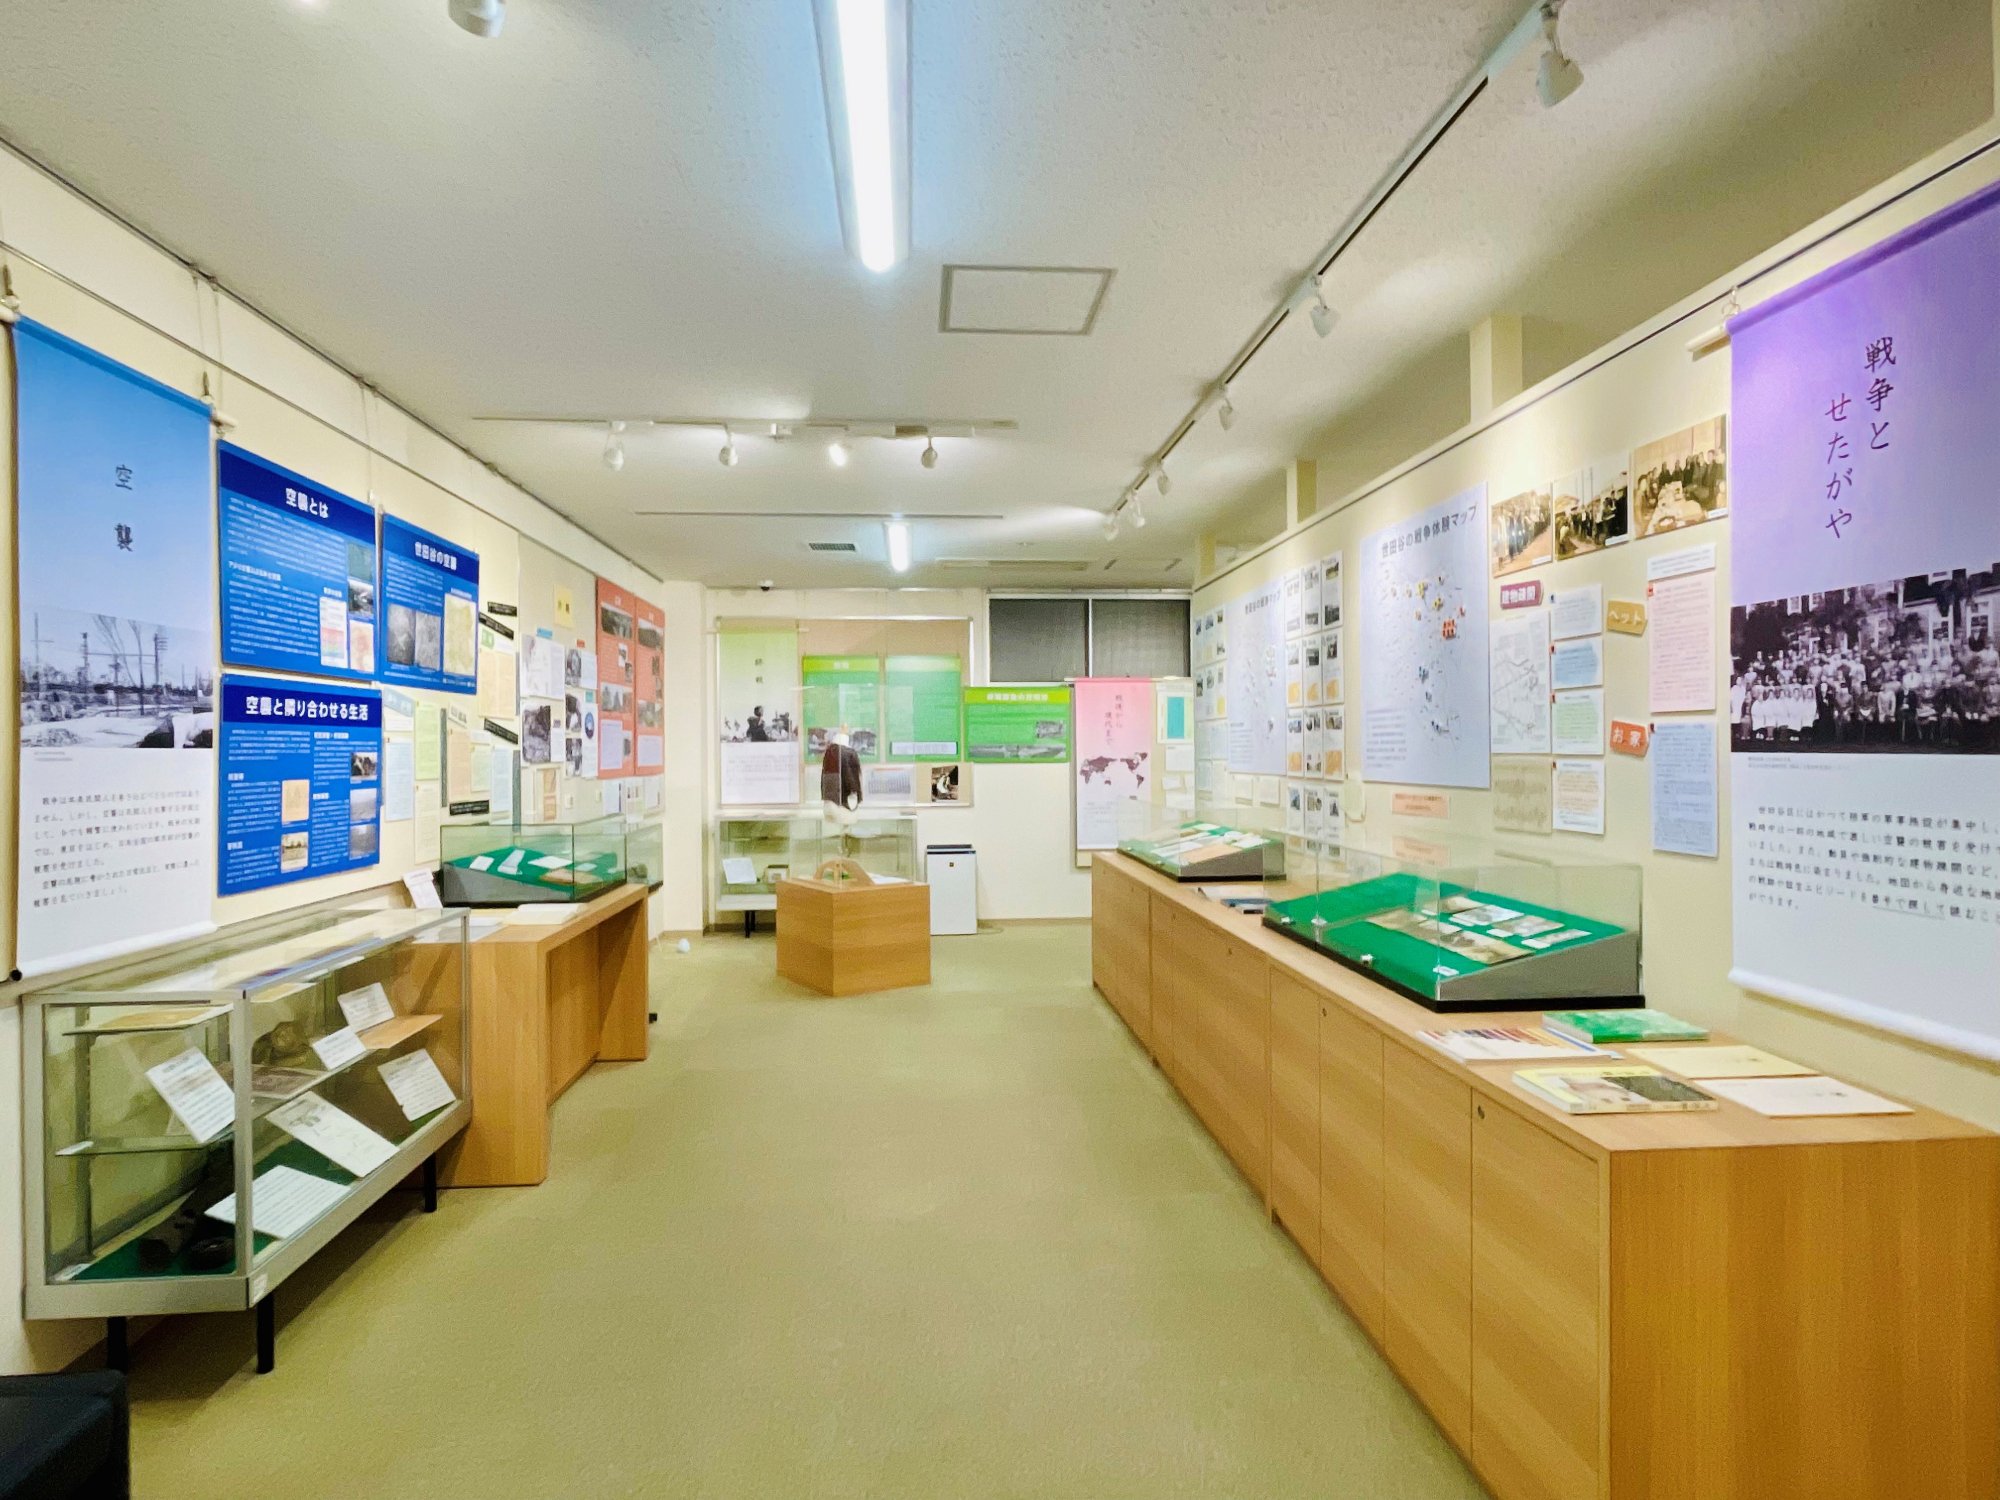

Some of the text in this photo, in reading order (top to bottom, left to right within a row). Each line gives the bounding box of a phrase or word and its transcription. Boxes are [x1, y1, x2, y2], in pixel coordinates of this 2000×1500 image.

[1864, 336, 1897, 451] 戦争と
[1825, 393, 1853, 539] せたがや
[114, 464, 134, 552] 空襲
[285, 487, 330, 519] 空襲とは
[1382, 502, 1477, 558] 世田谷の戦争体験マップ
[245, 695, 369, 721] 空襲と隣り合わせる生活
